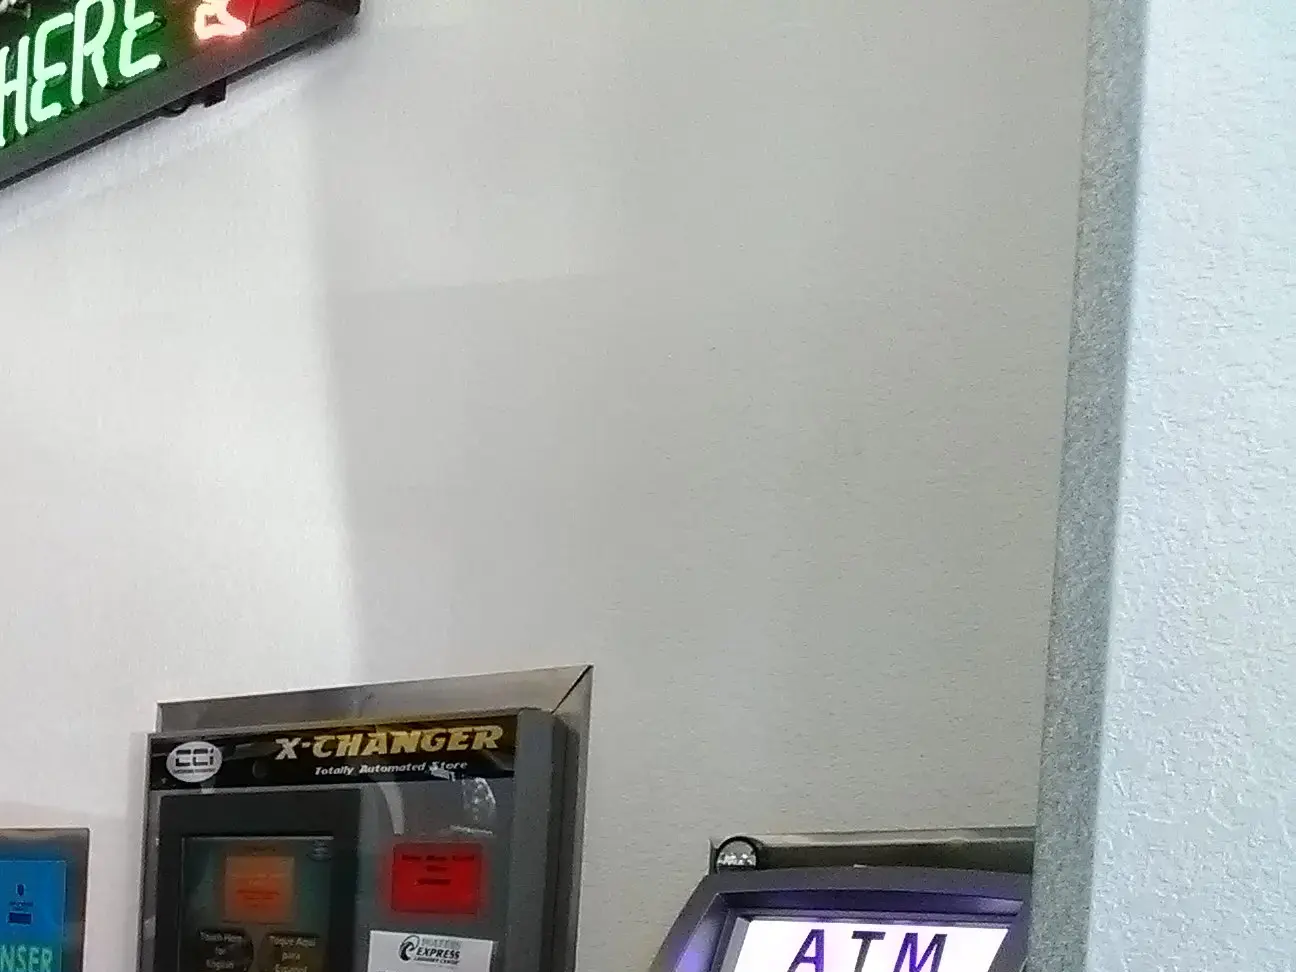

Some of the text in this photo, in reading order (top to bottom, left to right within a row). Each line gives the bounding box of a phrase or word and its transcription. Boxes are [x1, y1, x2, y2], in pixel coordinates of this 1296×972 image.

[274, 725, 504, 761] X-CHANGER
[315, 765, 355, 778] Totally
[359, 762, 427, 775] Automated
[428, 760, 468, 774] Store
[416, 947, 461, 960] EXPRESS
